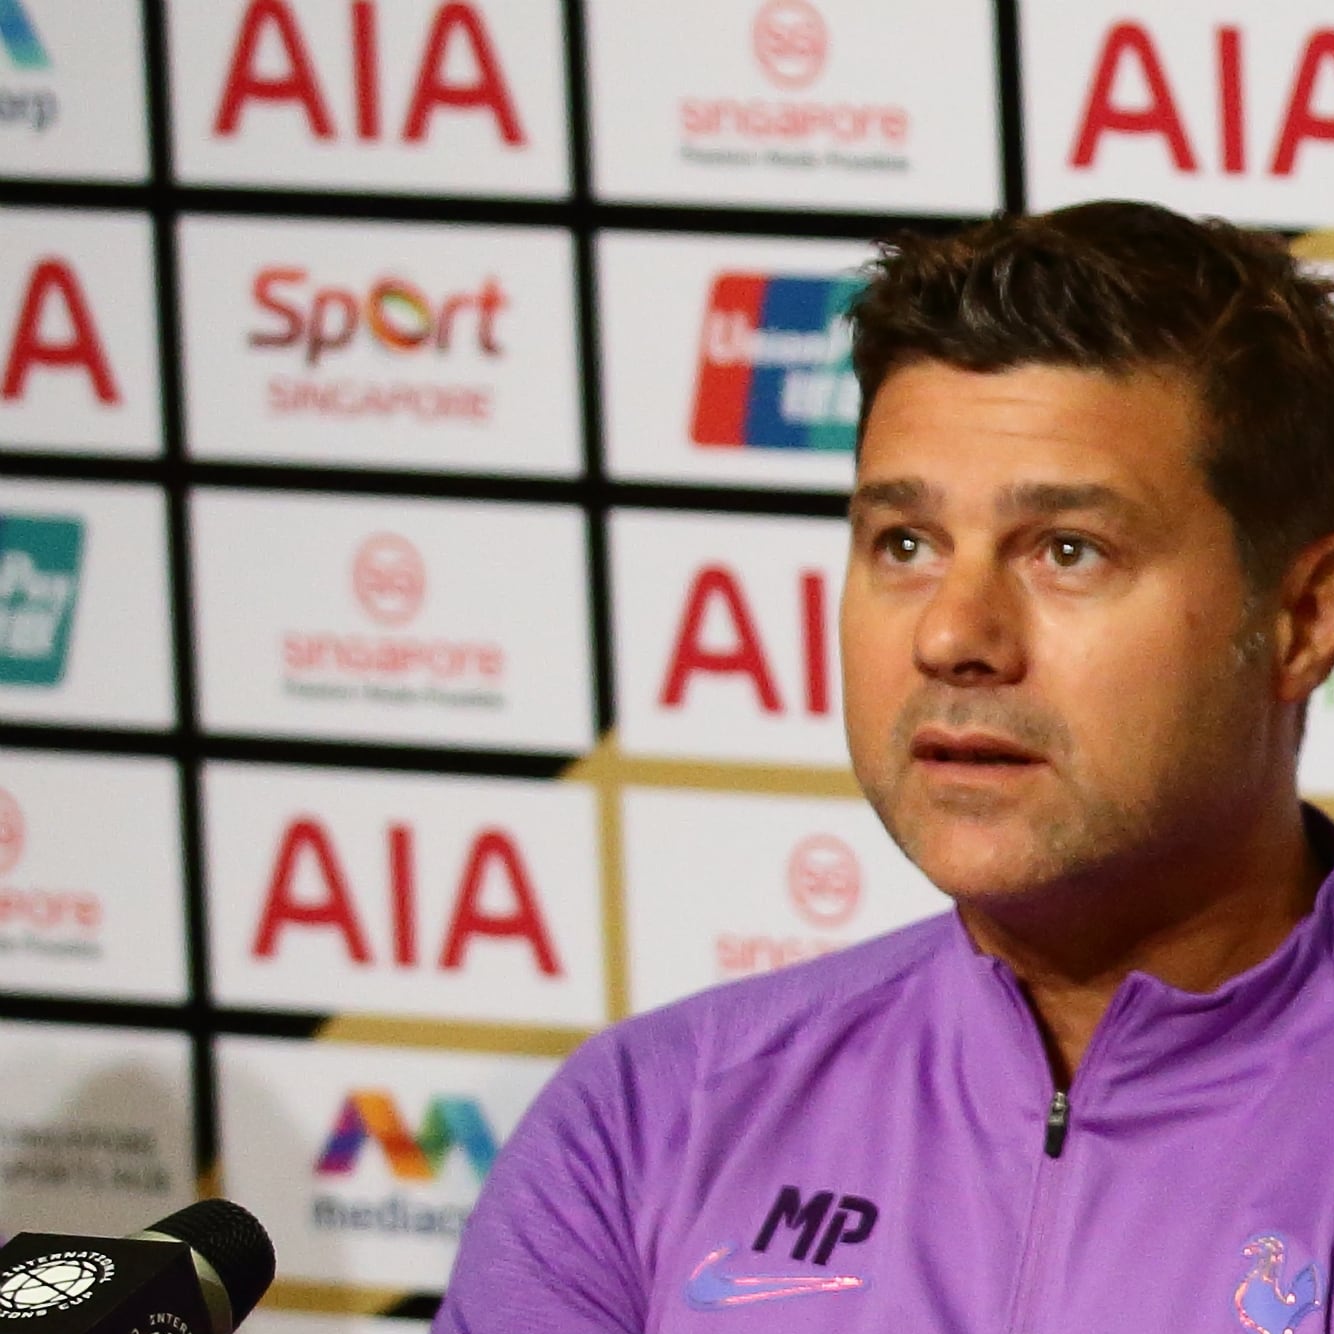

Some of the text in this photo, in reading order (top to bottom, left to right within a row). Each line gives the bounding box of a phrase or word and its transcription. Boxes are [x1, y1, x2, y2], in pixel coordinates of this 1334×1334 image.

[212, 0, 529, 147] AIA
[248, 266, 511, 363] Sport
[266, 378, 490, 420] SINGAPORE
[660, 560, 830, 718] AI
[250, 814, 563, 980] AIA
[752, 1184, 879, 1266] MP
